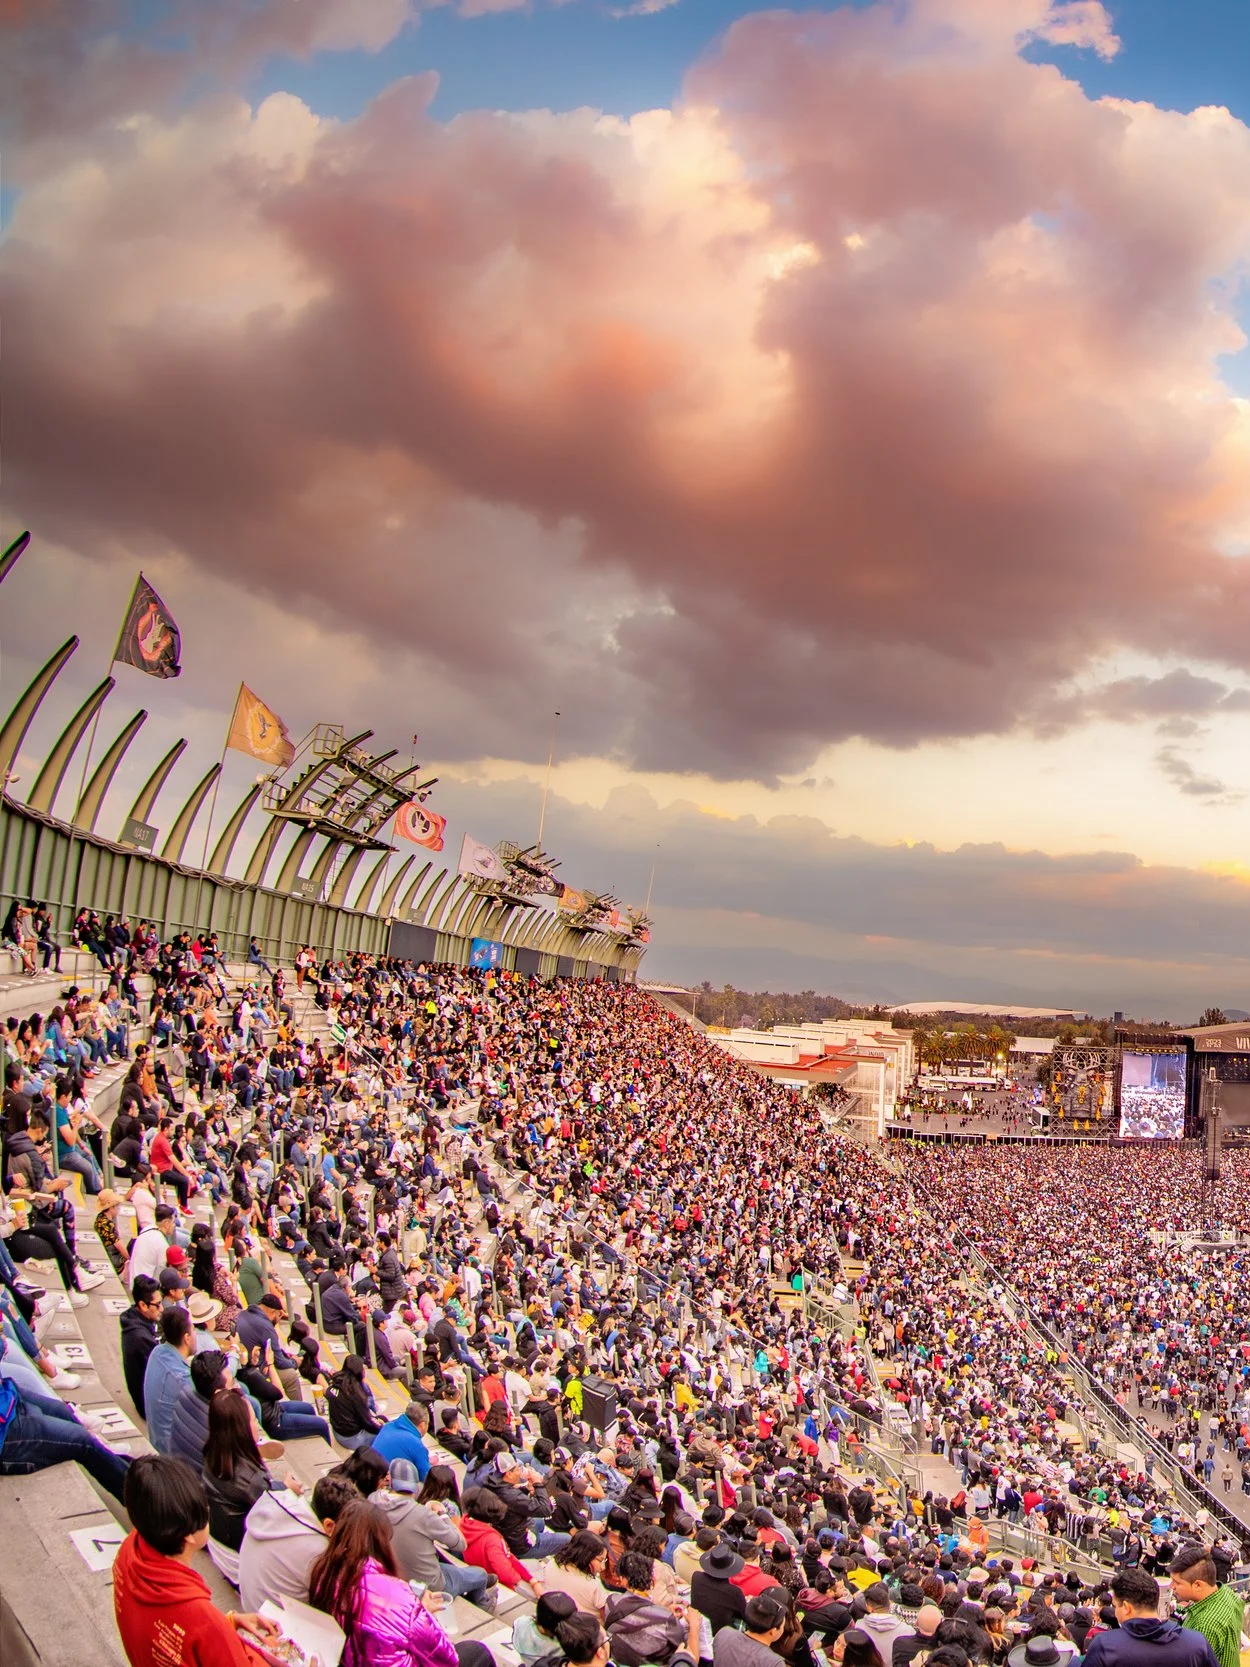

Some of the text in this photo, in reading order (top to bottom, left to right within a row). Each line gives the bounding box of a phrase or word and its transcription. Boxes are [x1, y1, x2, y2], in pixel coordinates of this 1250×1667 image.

[65, 1346, 84, 1358] 13
[99, 1412, 124, 1428] 11
[91, 1538, 121, 1552] 7
